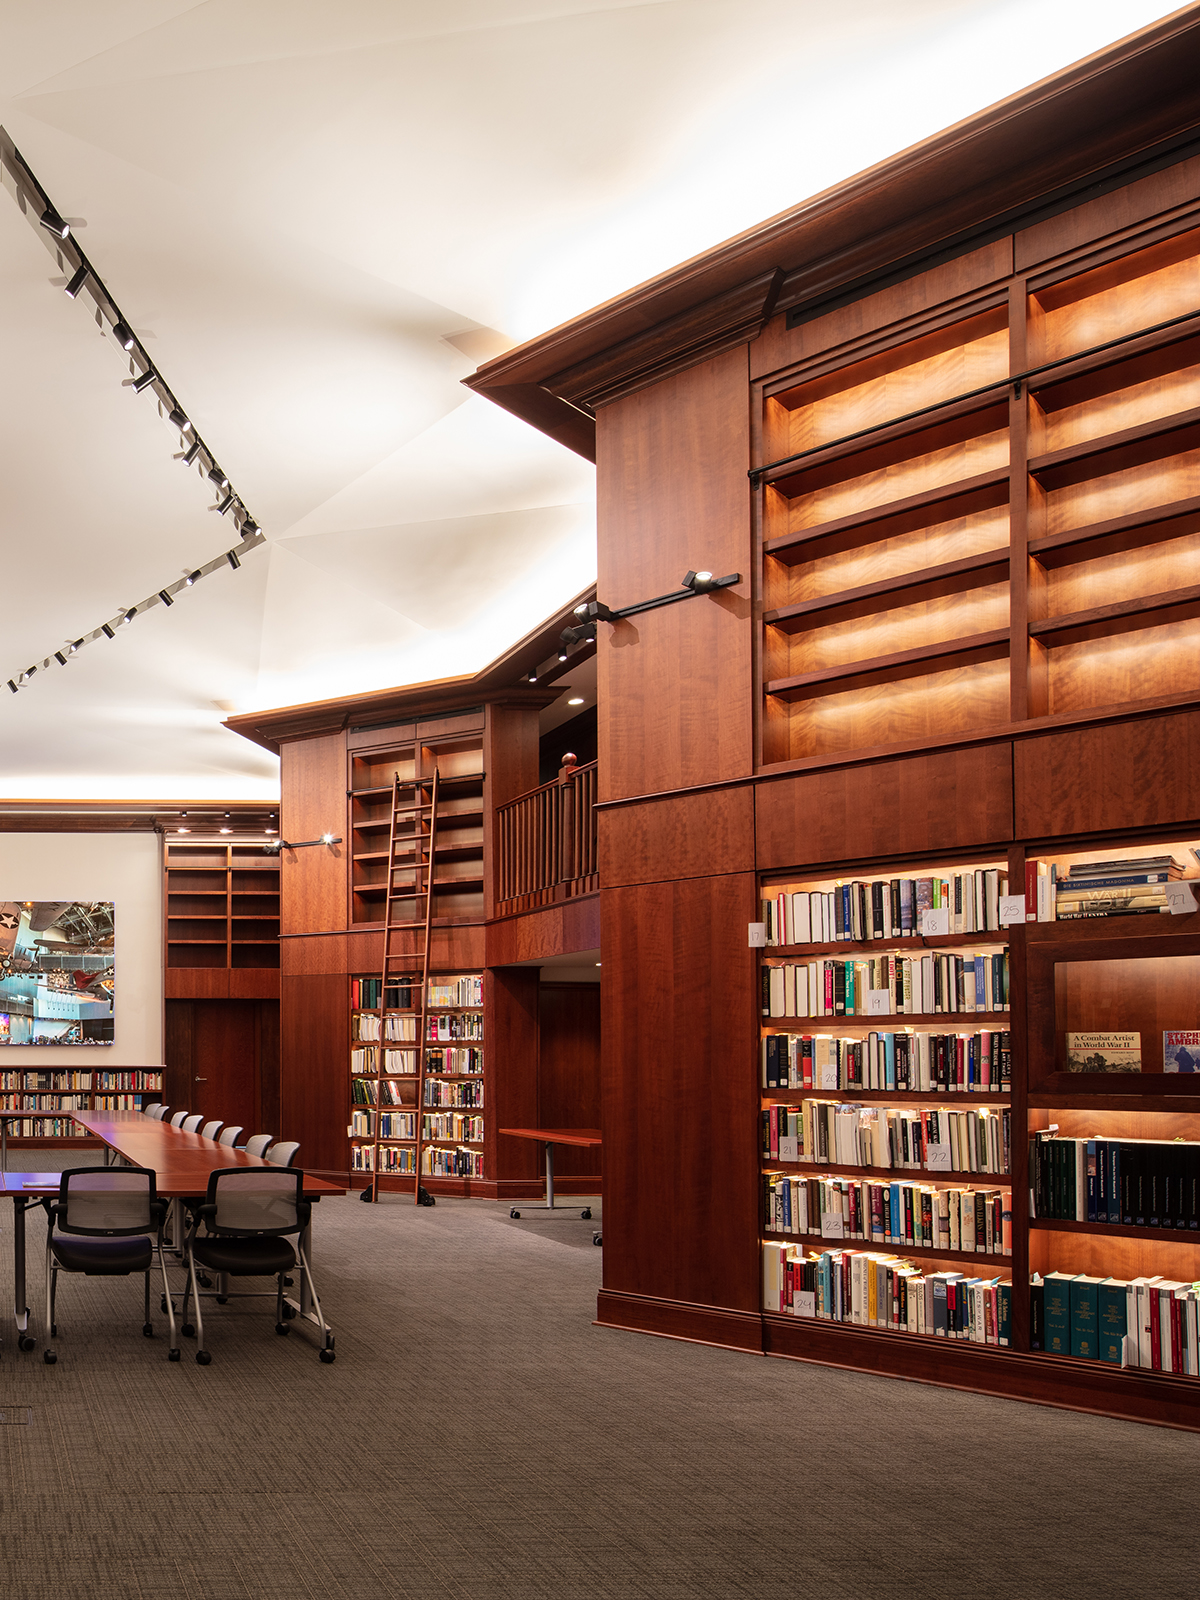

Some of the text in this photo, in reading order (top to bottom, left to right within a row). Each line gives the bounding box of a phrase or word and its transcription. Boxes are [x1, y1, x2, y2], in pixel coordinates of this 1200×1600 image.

[1087, 891, 1118, 900] WAR
[1169, 893, 1185, 906] 27
[1003, 905, 1020, 917] 25
[926, 920, 938, 932] 18
[751, 931, 760, 941] 17
[1168, 1038, 1200, 1046] AMBR
[825, 1073, 837, 1083] 20
[783, 1145, 792, 1154] 21
[931, 1152, 949, 1163] 22
[825, 1220, 842, 1231] 23
[976, 1213, 984, 1230] ELKINS
[797, 1299, 812, 1309] 24
